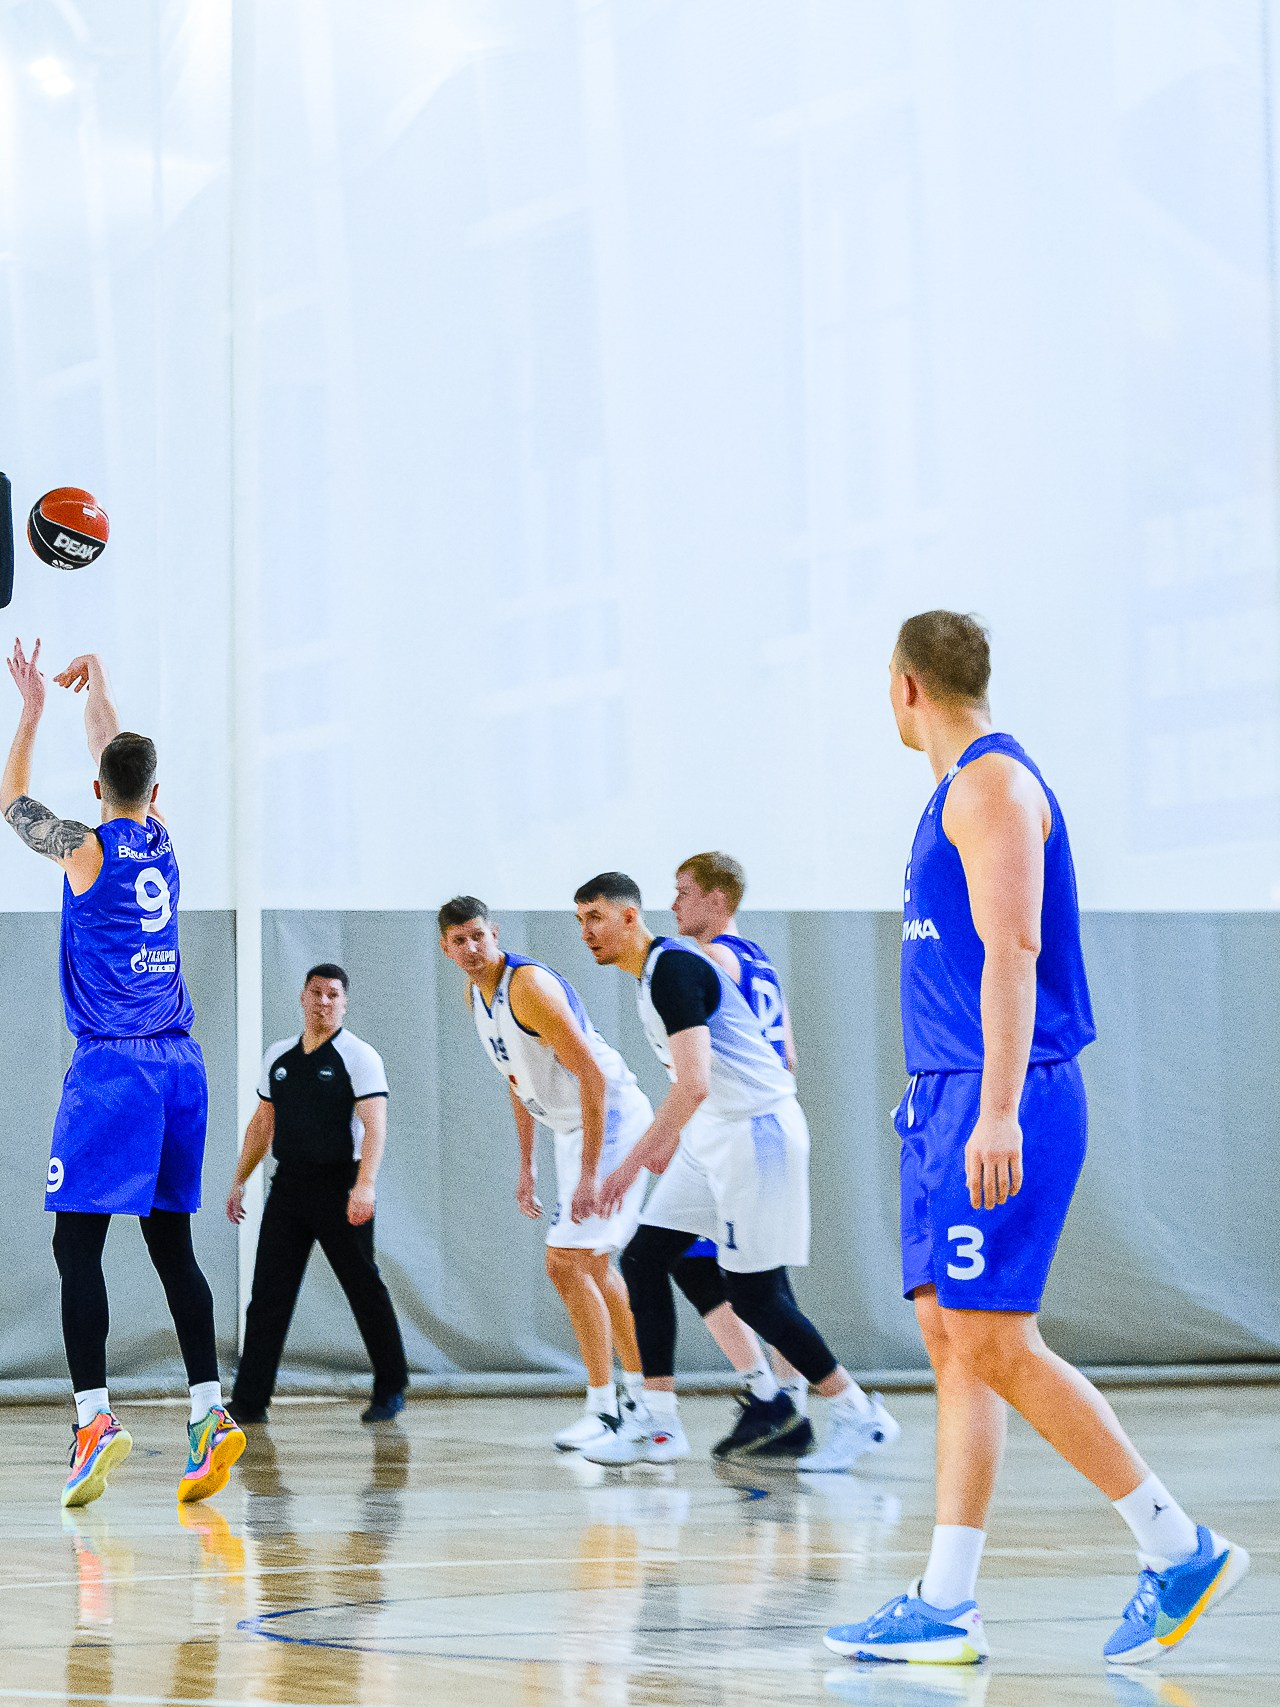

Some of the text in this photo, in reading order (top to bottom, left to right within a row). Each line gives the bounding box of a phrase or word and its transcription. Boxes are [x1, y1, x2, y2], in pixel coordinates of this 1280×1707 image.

[53, 532, 99, 560] PEAK
[135, 867, 172, 932] 9
[46, 1157, 65, 1193] 9
[947, 1225, 986, 1280] 3
